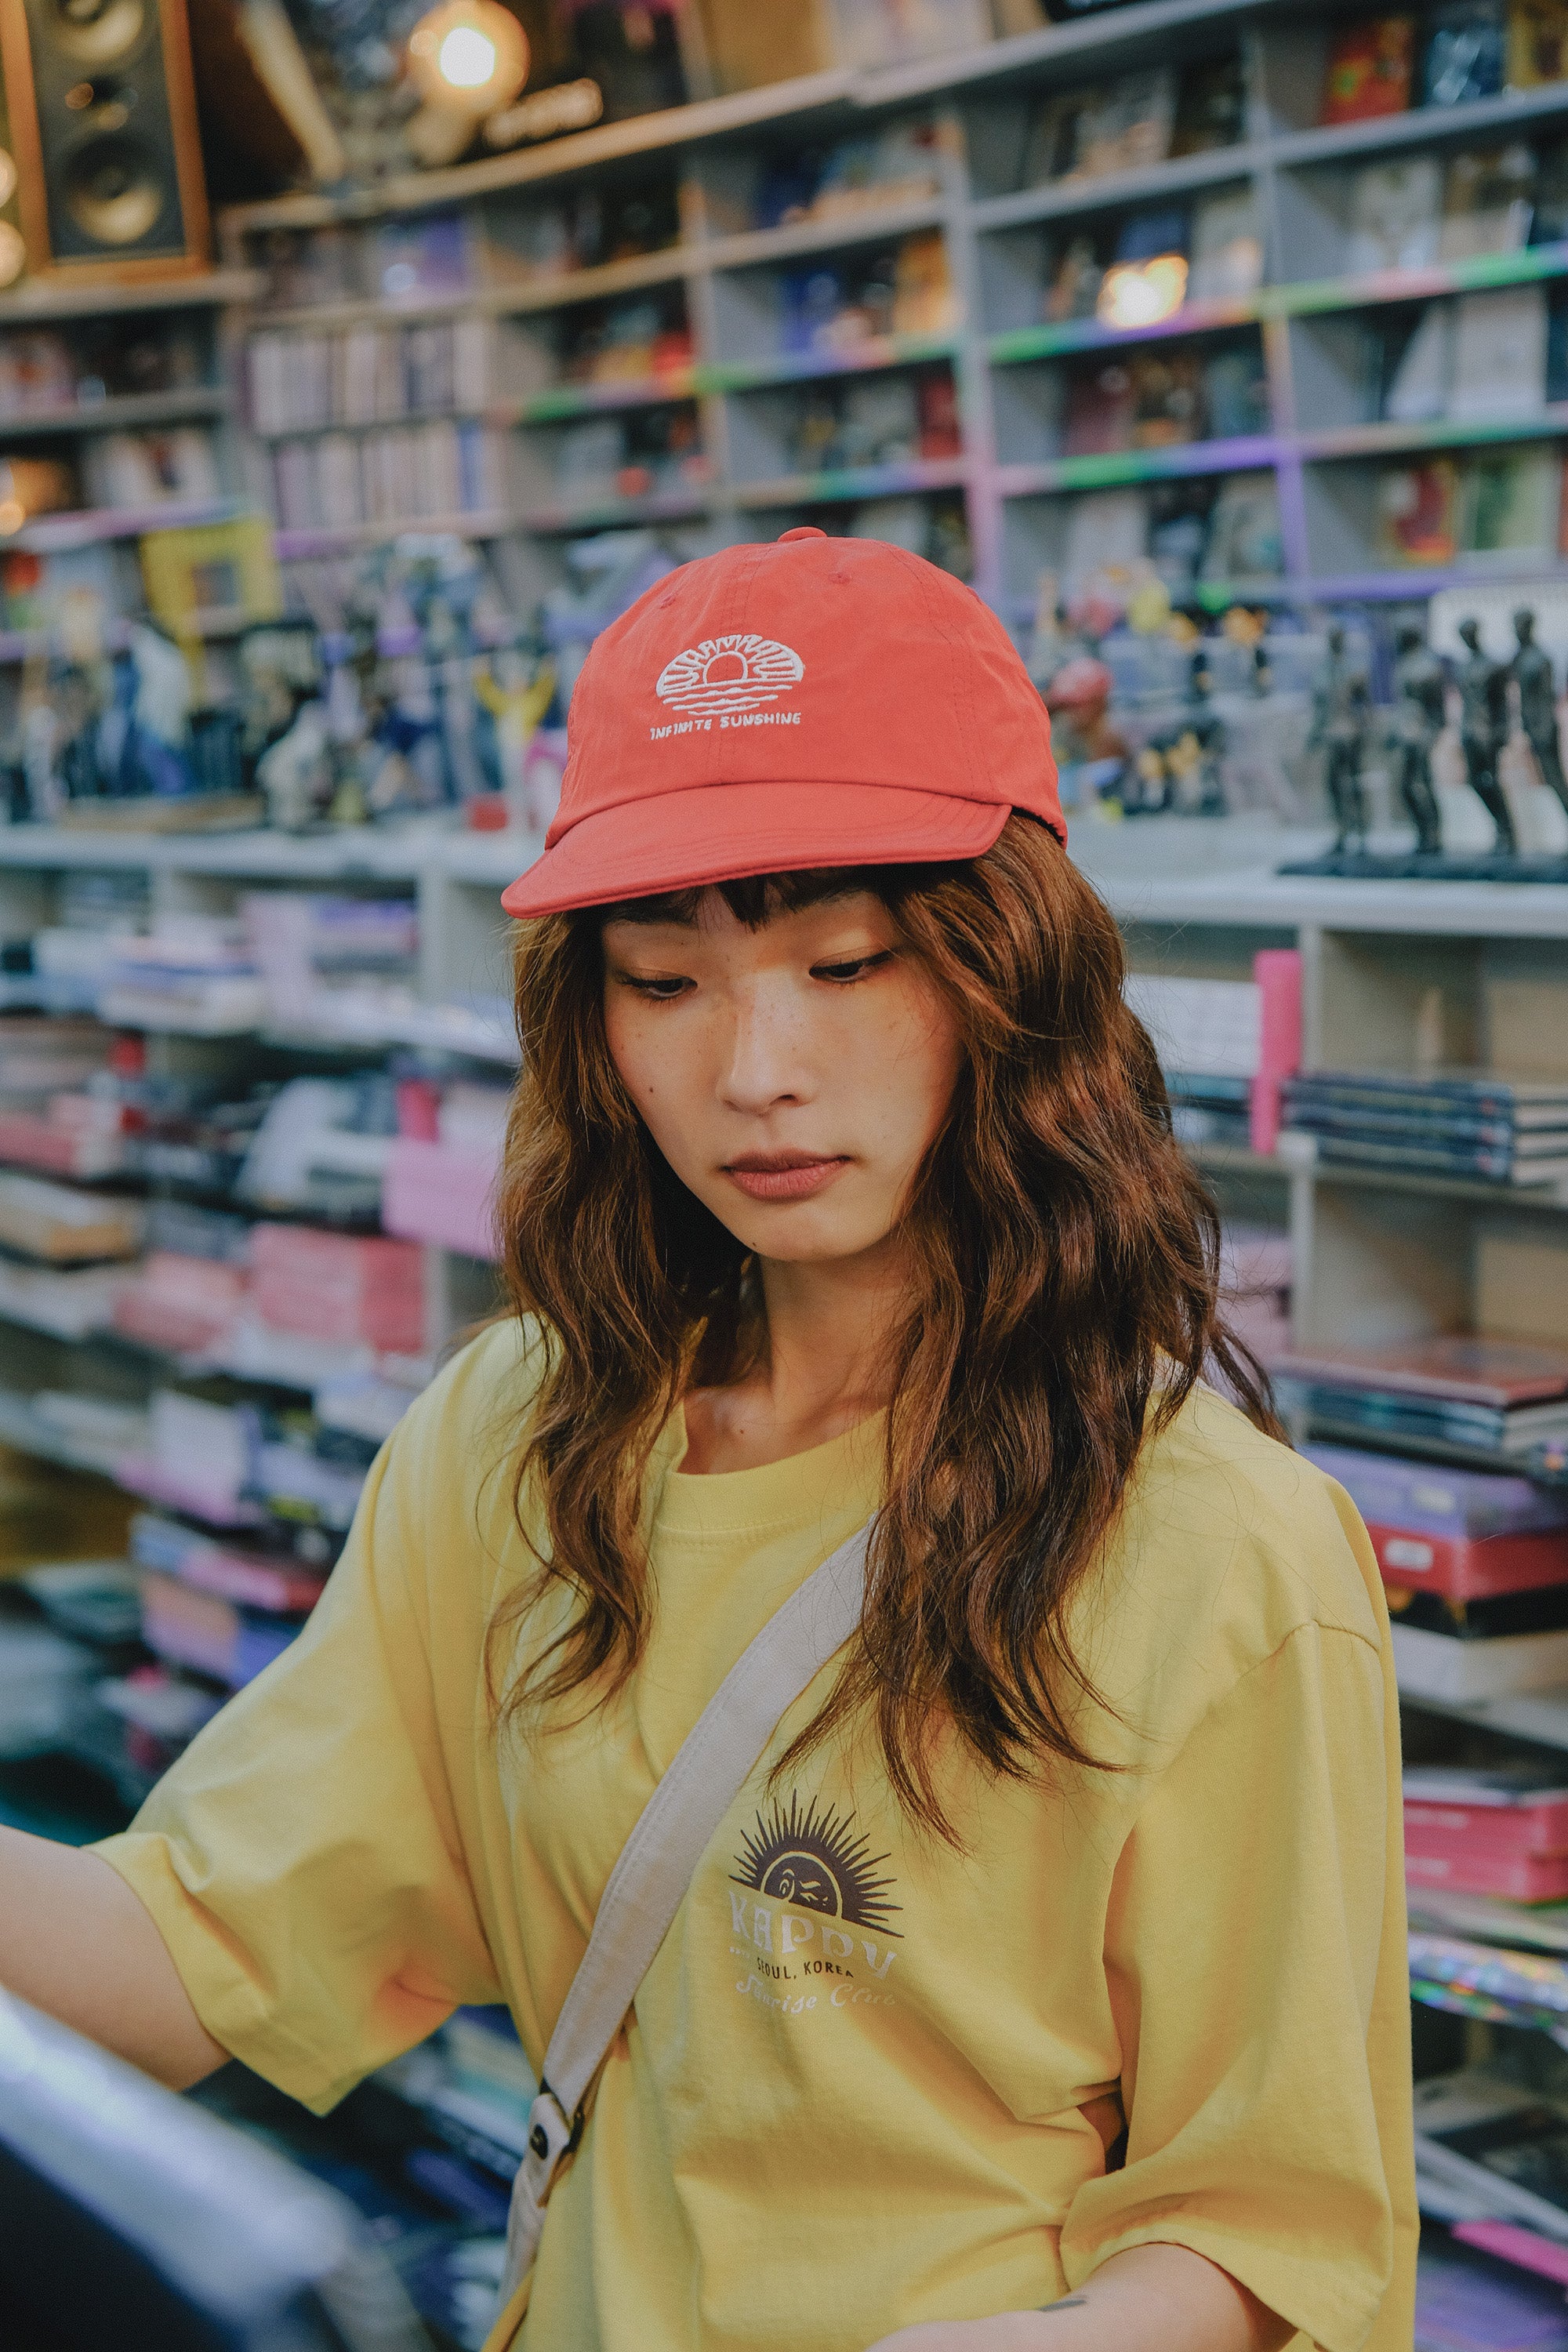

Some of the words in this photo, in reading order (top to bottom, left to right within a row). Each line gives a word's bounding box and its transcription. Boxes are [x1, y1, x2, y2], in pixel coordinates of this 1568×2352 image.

[650, 718, 713, 740] INFINITE
[720, 712, 802, 729] SUNSHINE
[757, 1957, 797, 1980] SEOUL,
[804, 1960, 855, 1978] KOREA
